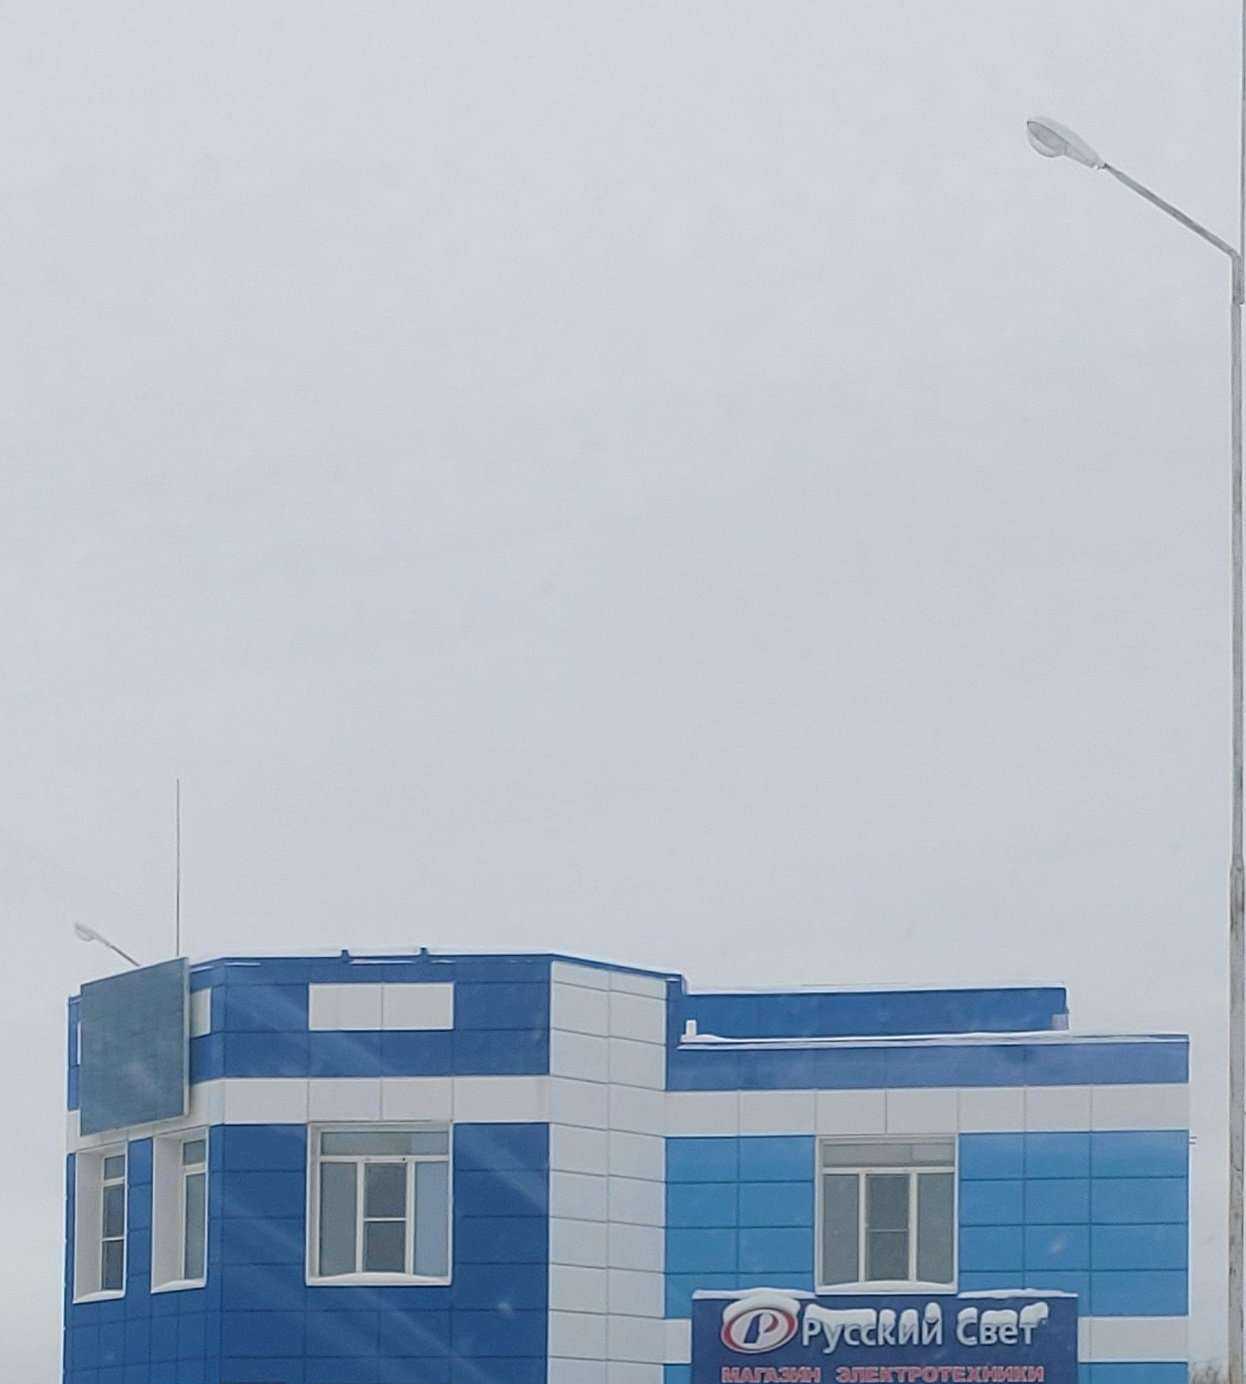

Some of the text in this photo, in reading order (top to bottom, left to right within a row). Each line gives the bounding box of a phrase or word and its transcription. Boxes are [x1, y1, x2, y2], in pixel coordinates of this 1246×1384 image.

[802, 1315, 1037, 1354] Русский Свет
[721, 1365, 1045, 1383] МАГАЗИН ЭЛЕКТРОТЕХНИКИ
